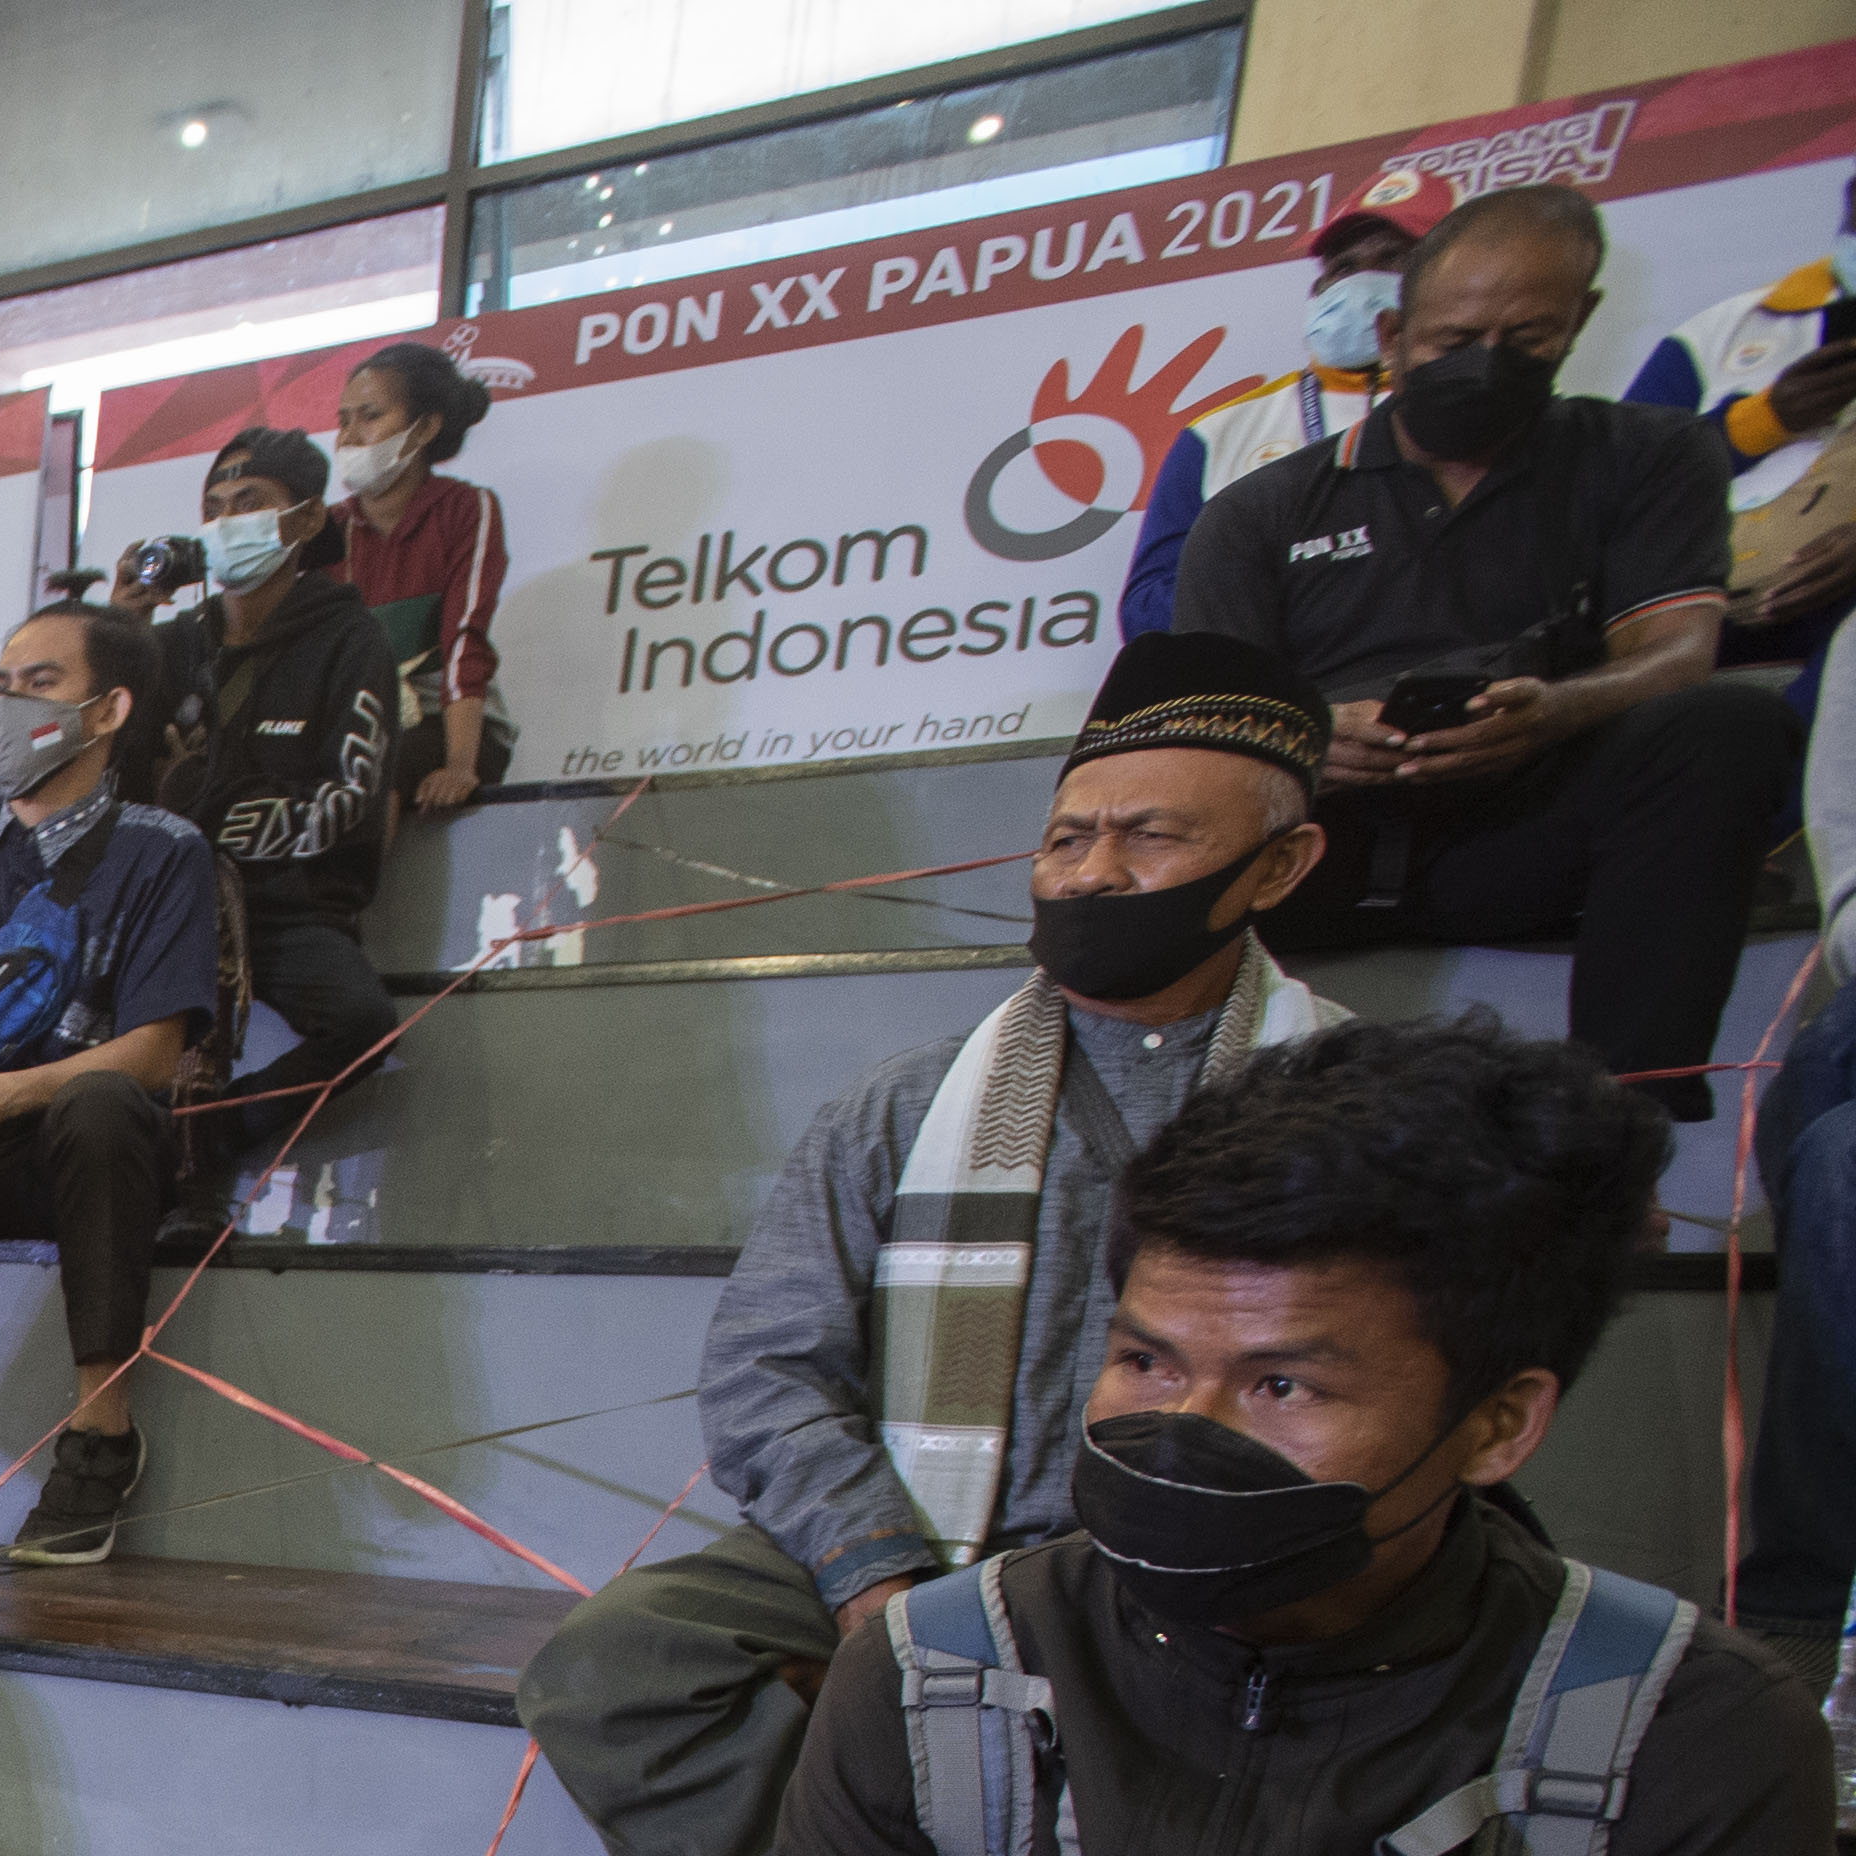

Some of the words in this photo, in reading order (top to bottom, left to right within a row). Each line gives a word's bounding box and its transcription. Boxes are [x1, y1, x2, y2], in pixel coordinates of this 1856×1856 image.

[1450, 99, 1637, 207] ISA!
[574, 291, 723, 366] PON
[742, 267, 850, 336] XX
[865, 211, 1146, 312] PAPUA
[1159, 173, 1336, 260] 2021
[590, 523, 929, 617] Telkom
[618, 588, 1100, 696] Indonesia
[561, 744, 625, 777] the
[636, 730, 750, 769] world
[756, 727, 792, 758] in
[807, 721, 906, 760] your
[912, 702, 1033, 745] hand
